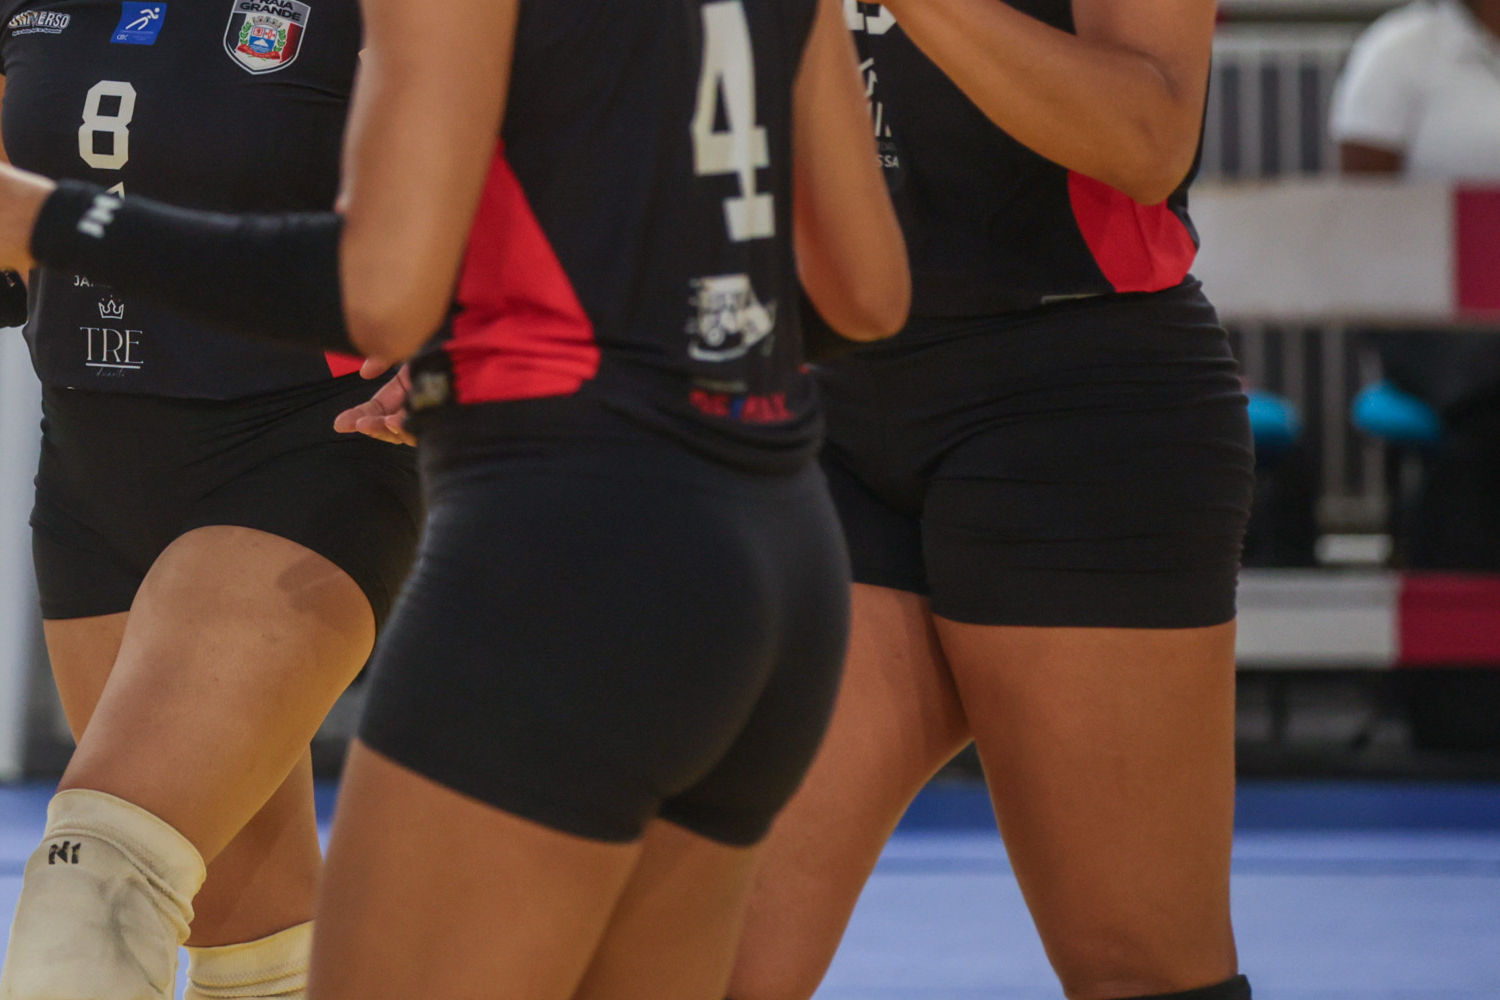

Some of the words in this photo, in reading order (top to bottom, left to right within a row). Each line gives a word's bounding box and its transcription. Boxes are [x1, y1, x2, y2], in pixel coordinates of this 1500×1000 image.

[240, 2, 302, 21] GRANDE
[77, 80, 137, 170] 8
[80, 326, 144, 364] TRE
